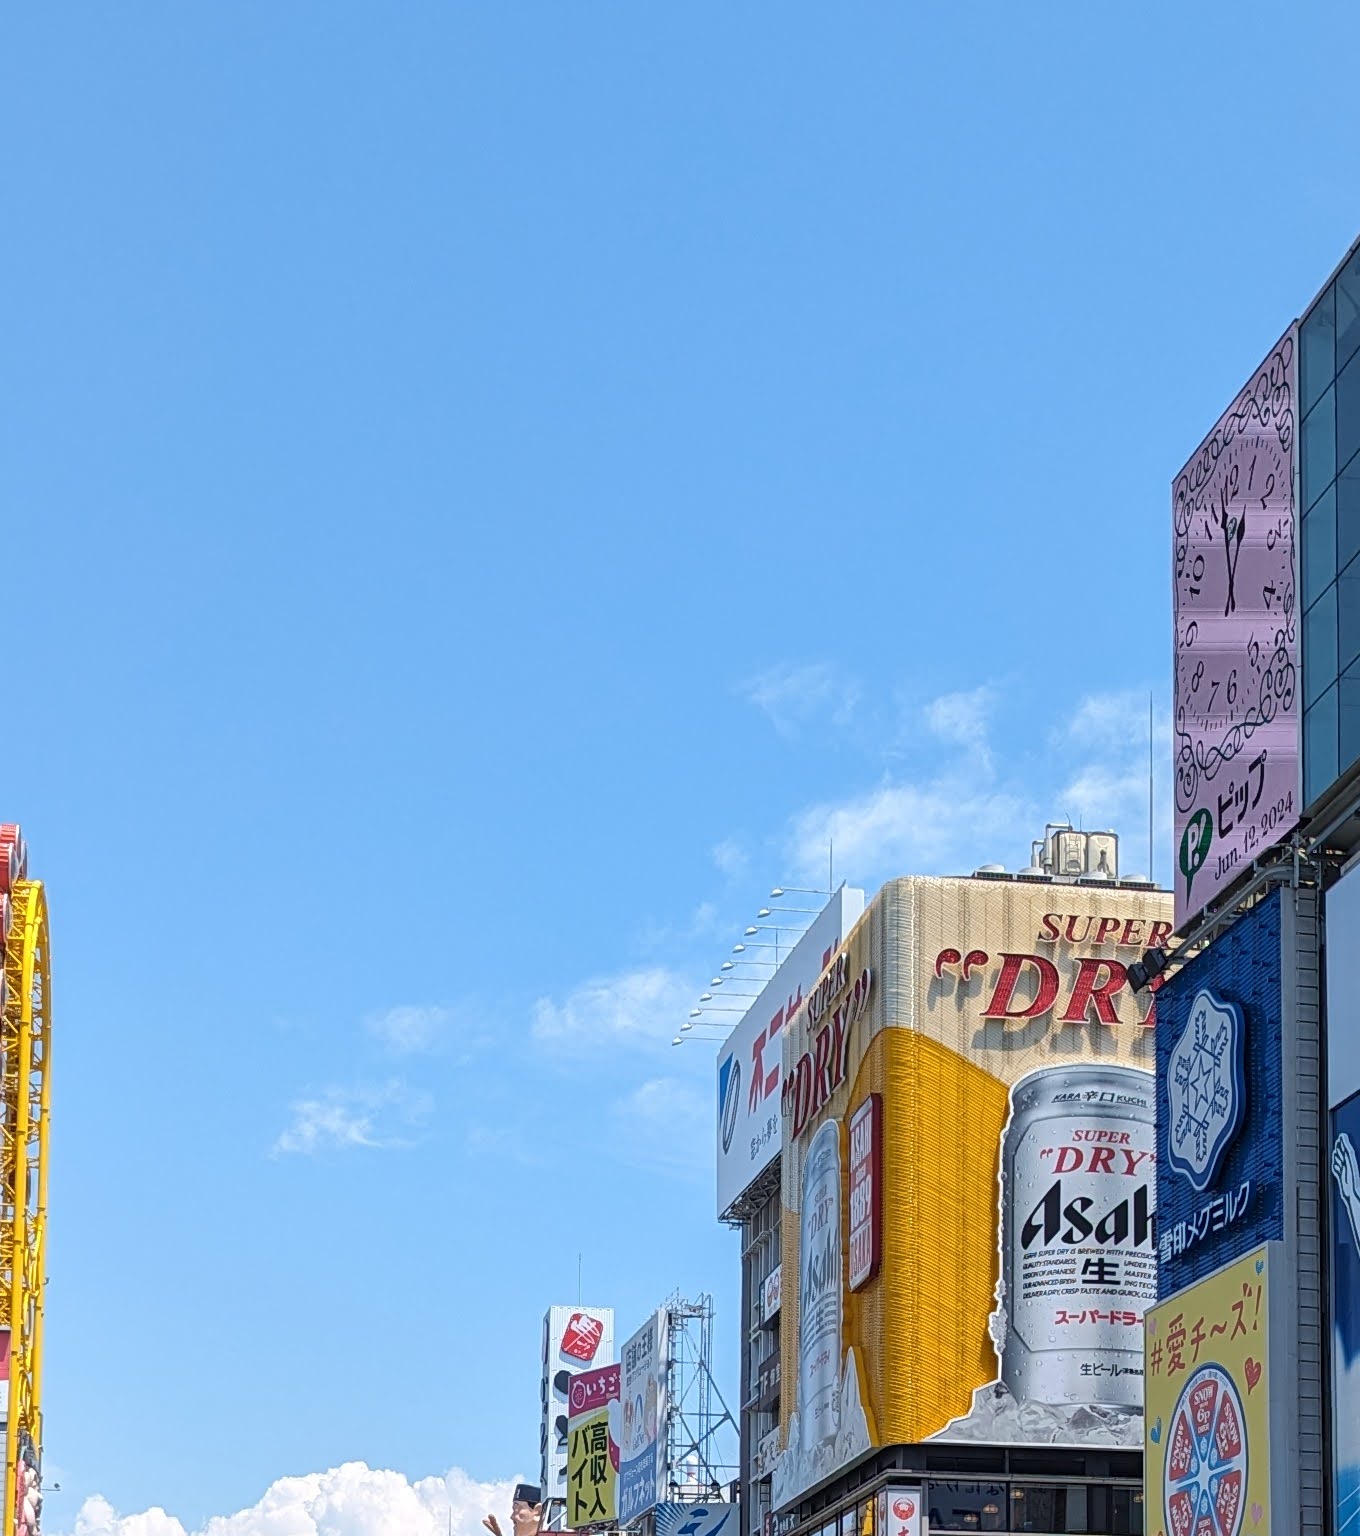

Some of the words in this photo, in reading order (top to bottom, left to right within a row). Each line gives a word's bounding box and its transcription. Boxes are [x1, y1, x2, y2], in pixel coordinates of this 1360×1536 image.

[1217, 748, 1268, 840] ピップ
[1215, 852, 1242, 881] Jun.
[1257, 791, 1293, 831] 2024
[1038, 912, 1173, 950] SUPER
[806, 951, 848, 1033] SUPER
[1052, 1092, 1081, 1103] KARA
[1072, 1129, 1131, 1146] SUPER
[1020, 1178, 1159, 1250] Asah
[1159, 1178, 1250, 1264] 雪印メグミルク
[1081, 1258, 1121, 1285] 生
[1124, 1270, 1151, 1279] MASTER
[1193, 1384, 1214, 1400] SNOW
[571, 1426, 590, 1522] バイト
[589, 1421, 609, 1520] 高収入
